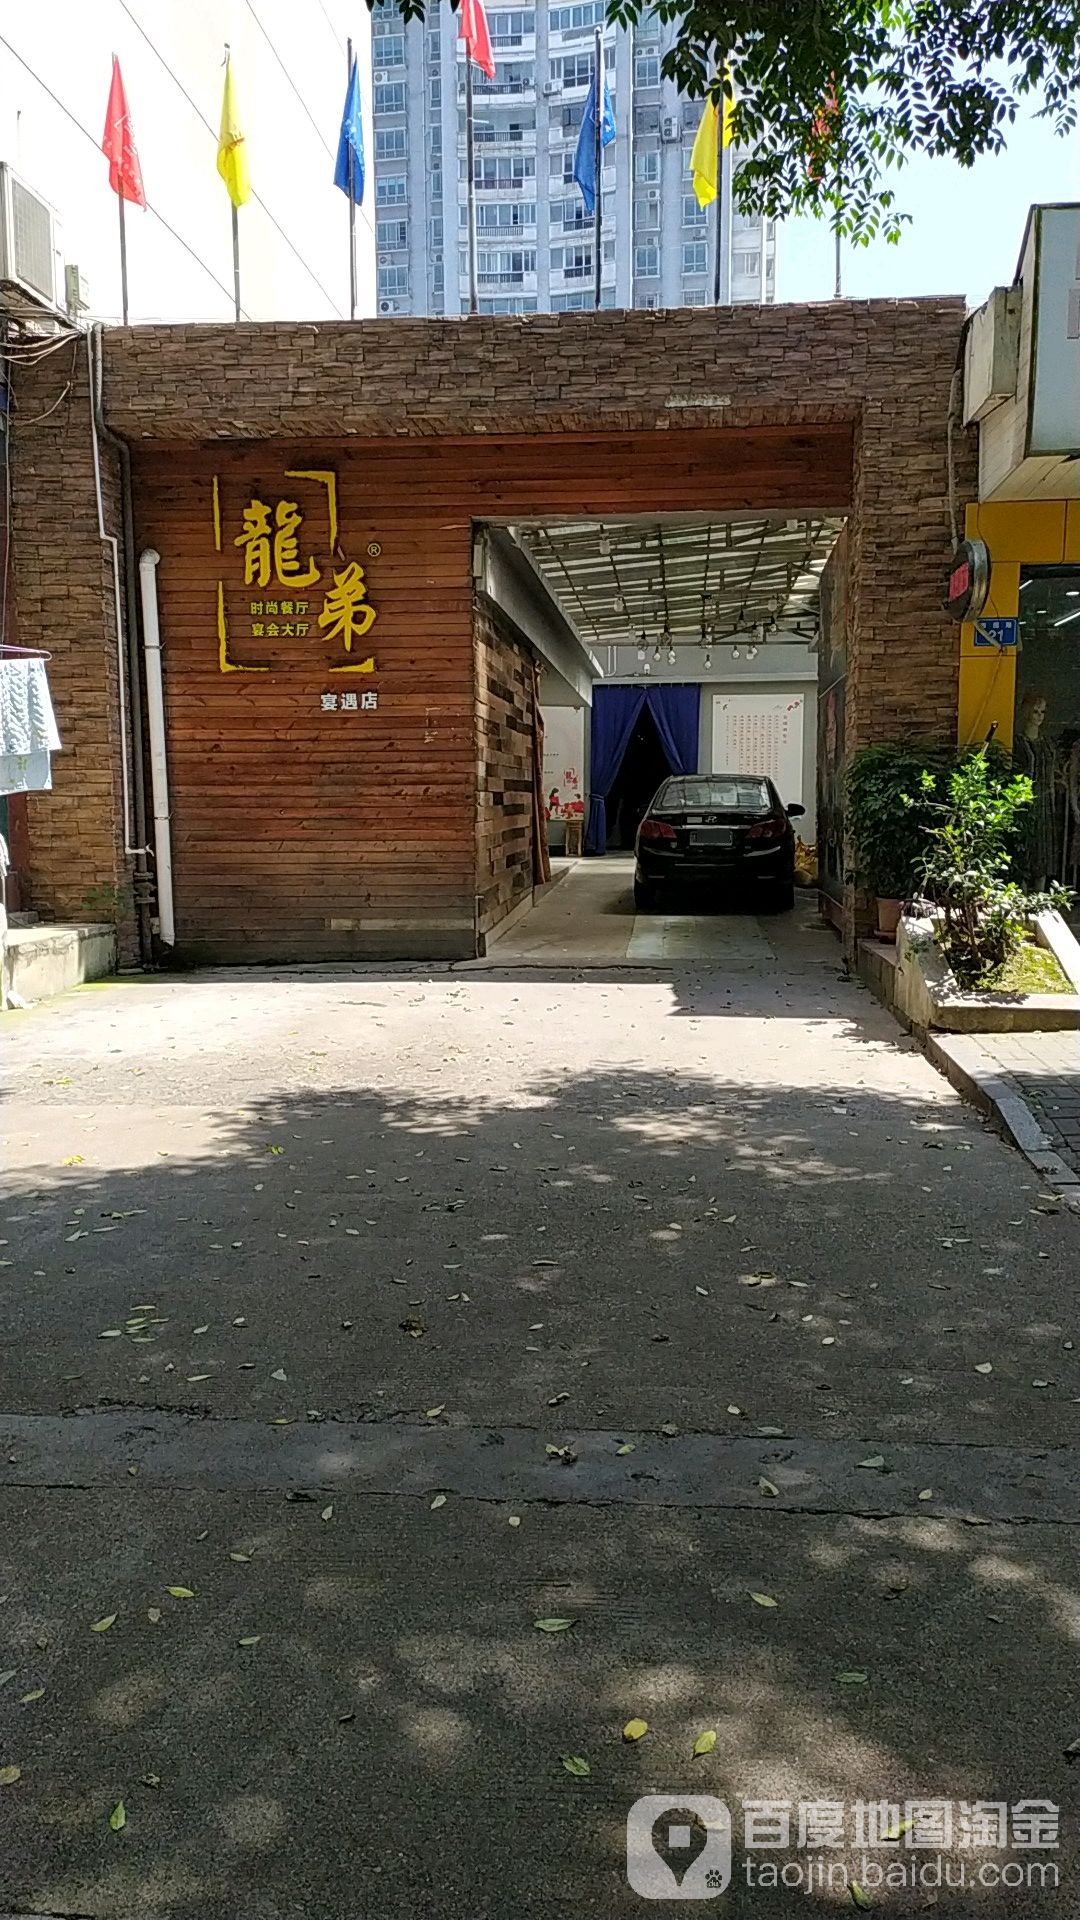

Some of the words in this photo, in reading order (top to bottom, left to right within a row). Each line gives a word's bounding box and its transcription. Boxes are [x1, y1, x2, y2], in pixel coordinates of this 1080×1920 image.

[250, 601, 309, 615] 时尚餐厅
[251, 623, 309, 637] 宴会大厅
[320, 691, 378, 711] 宴遇店
